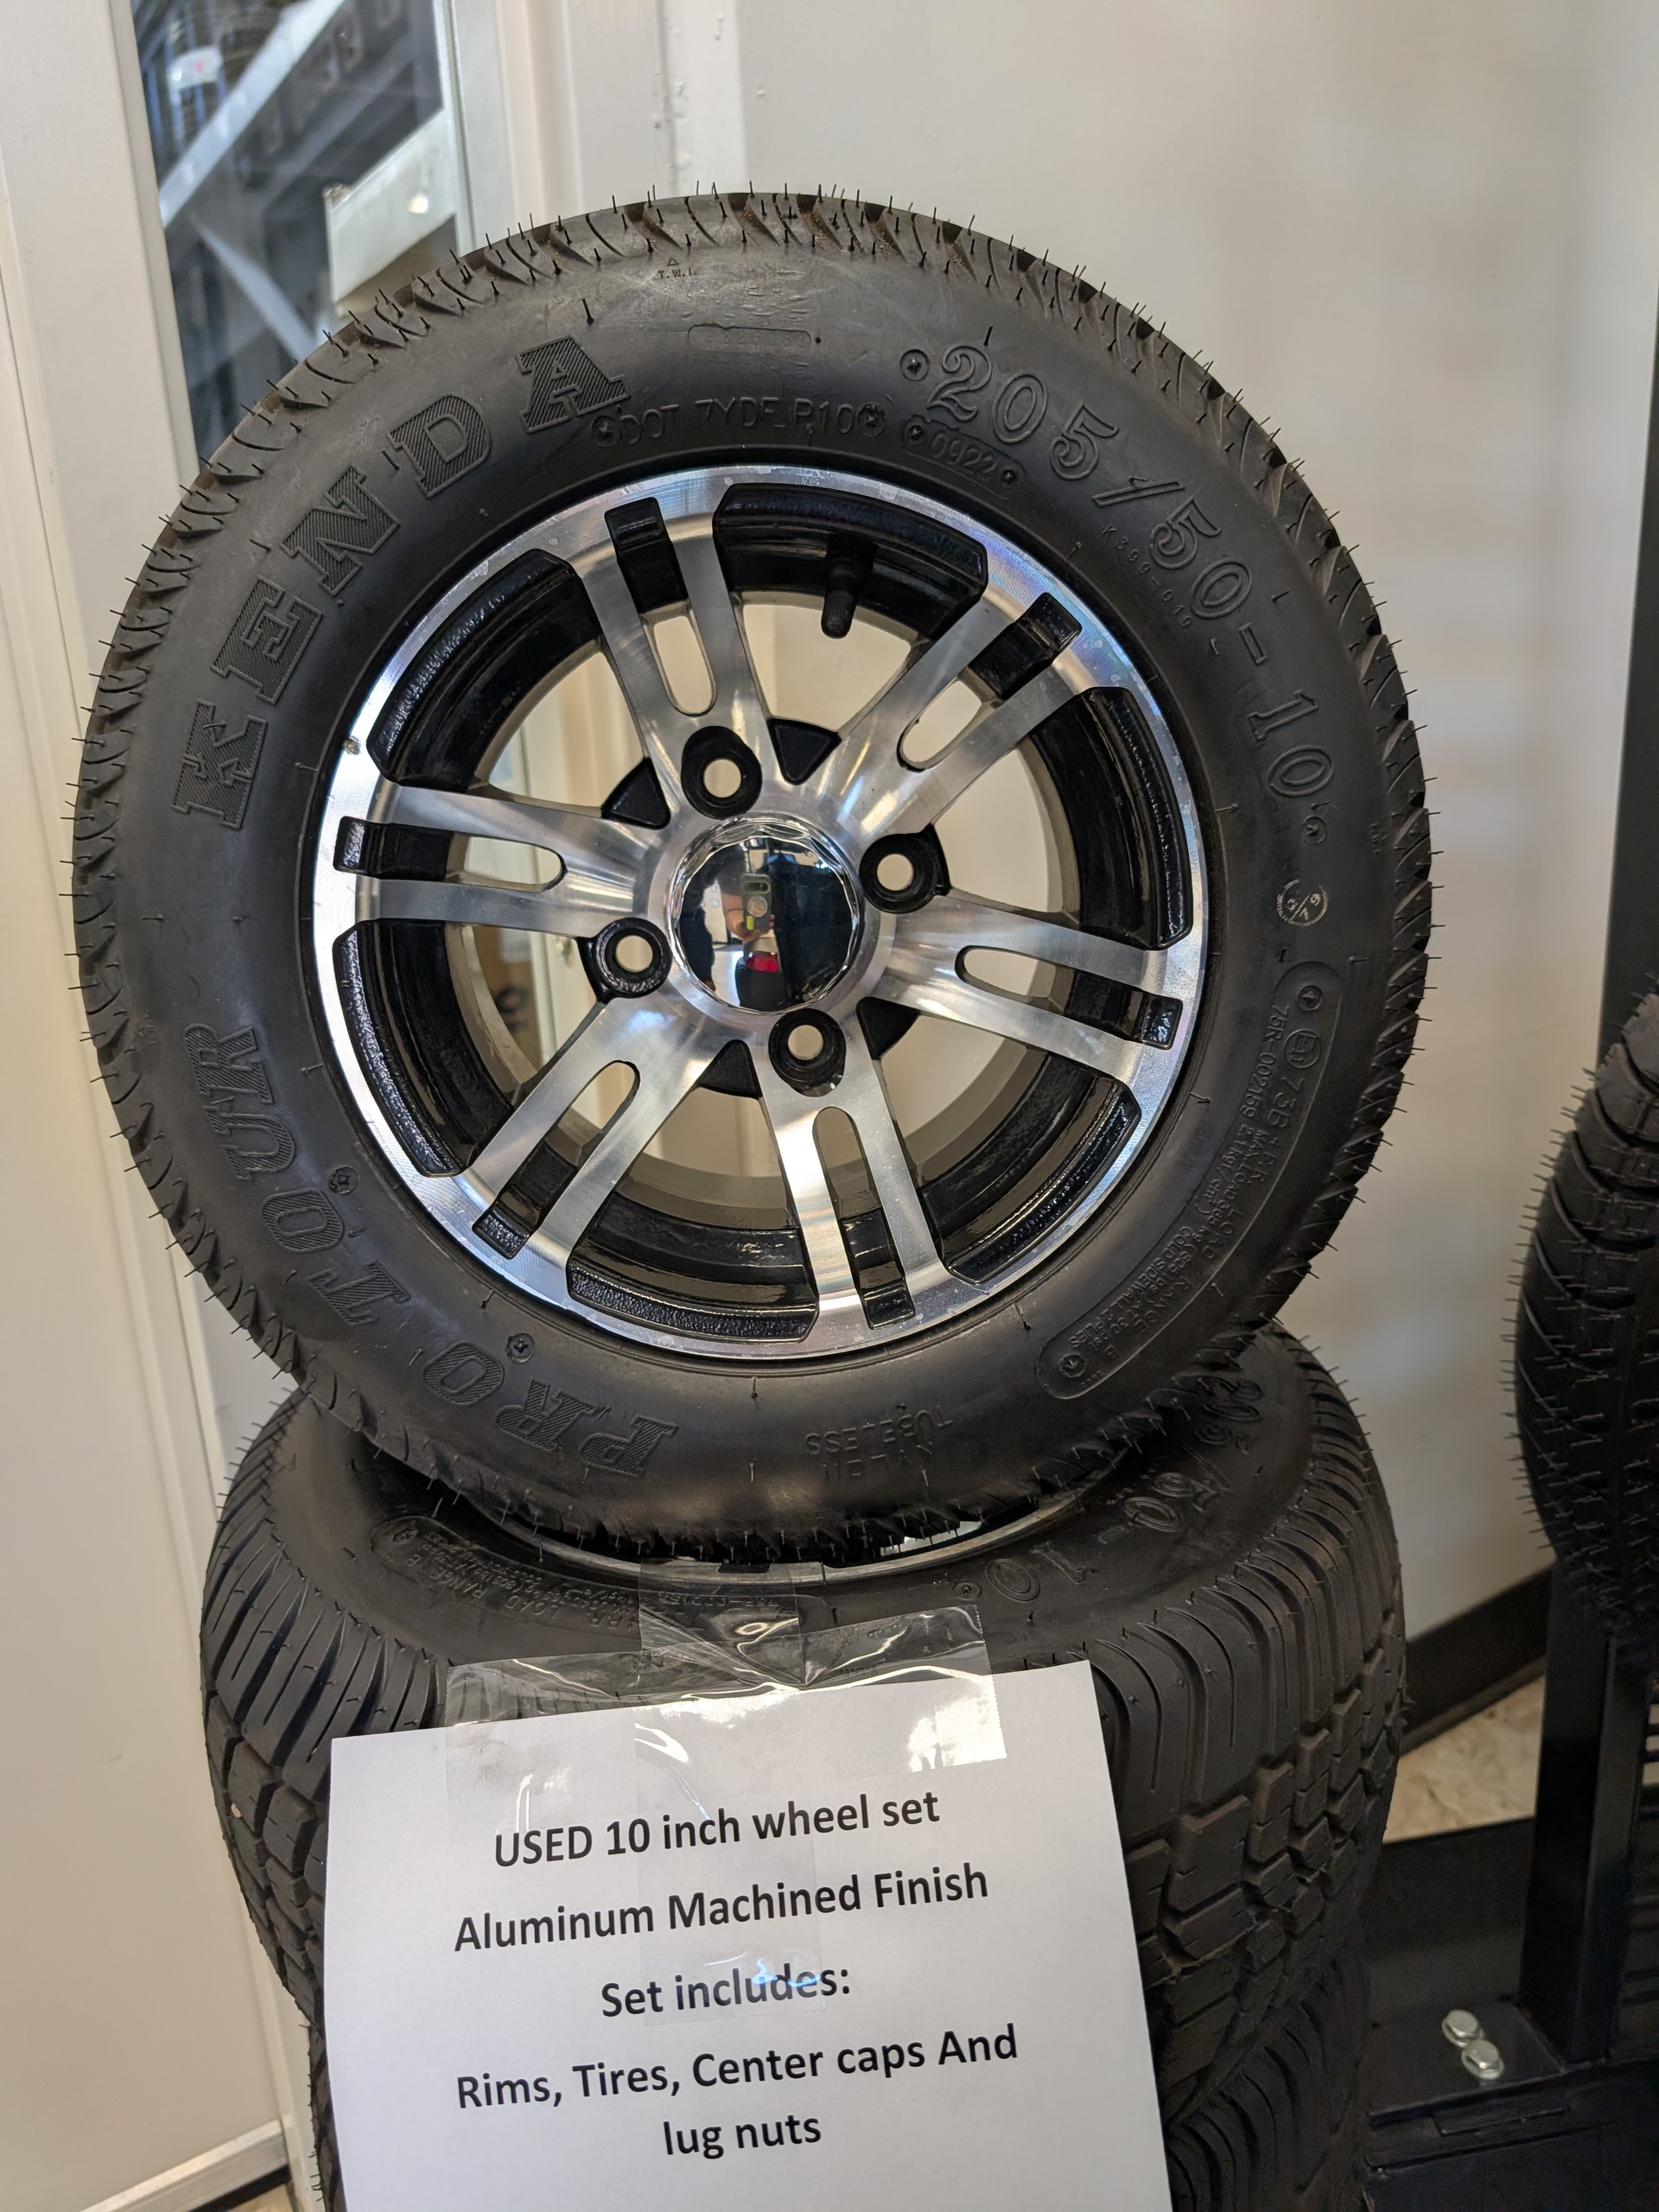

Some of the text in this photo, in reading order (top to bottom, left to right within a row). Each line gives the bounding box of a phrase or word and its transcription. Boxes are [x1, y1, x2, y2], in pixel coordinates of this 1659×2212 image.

[620, 404, 680, 446] DOT
[930, 435, 1001, 480] 0922
[172, 334, 631, 830] KENDA
[925, 346, 1335, 798] 205/50-10
[1237, 1002, 1290, 1121] 75R-002159
[1265, 1072, 1305, 1130] 73B
[185, 1023, 678, 1478] PRO TOUR
[1160, 1224, 1193, 1261] COLD
[1200, 1207, 1243, 1261] LOAD
[1109, 1255, 1167, 1314] SIDEWALL
[1133, 1274, 1192, 1335] RANGE
[1066, 1314, 1105, 1349] PLIES
[1101, 1342, 1122, 1363] B
[496, 1793, 939, 1866] USED 10 inch wheel set
[455, 1863, 988, 1951] Aluminum Machined Finish
[602, 1963, 849, 2017] Set includes:
[458, 2024, 1017, 2108] Rims, Tires, Center caps And
[664, 2115, 821, 2159] lug nuts
